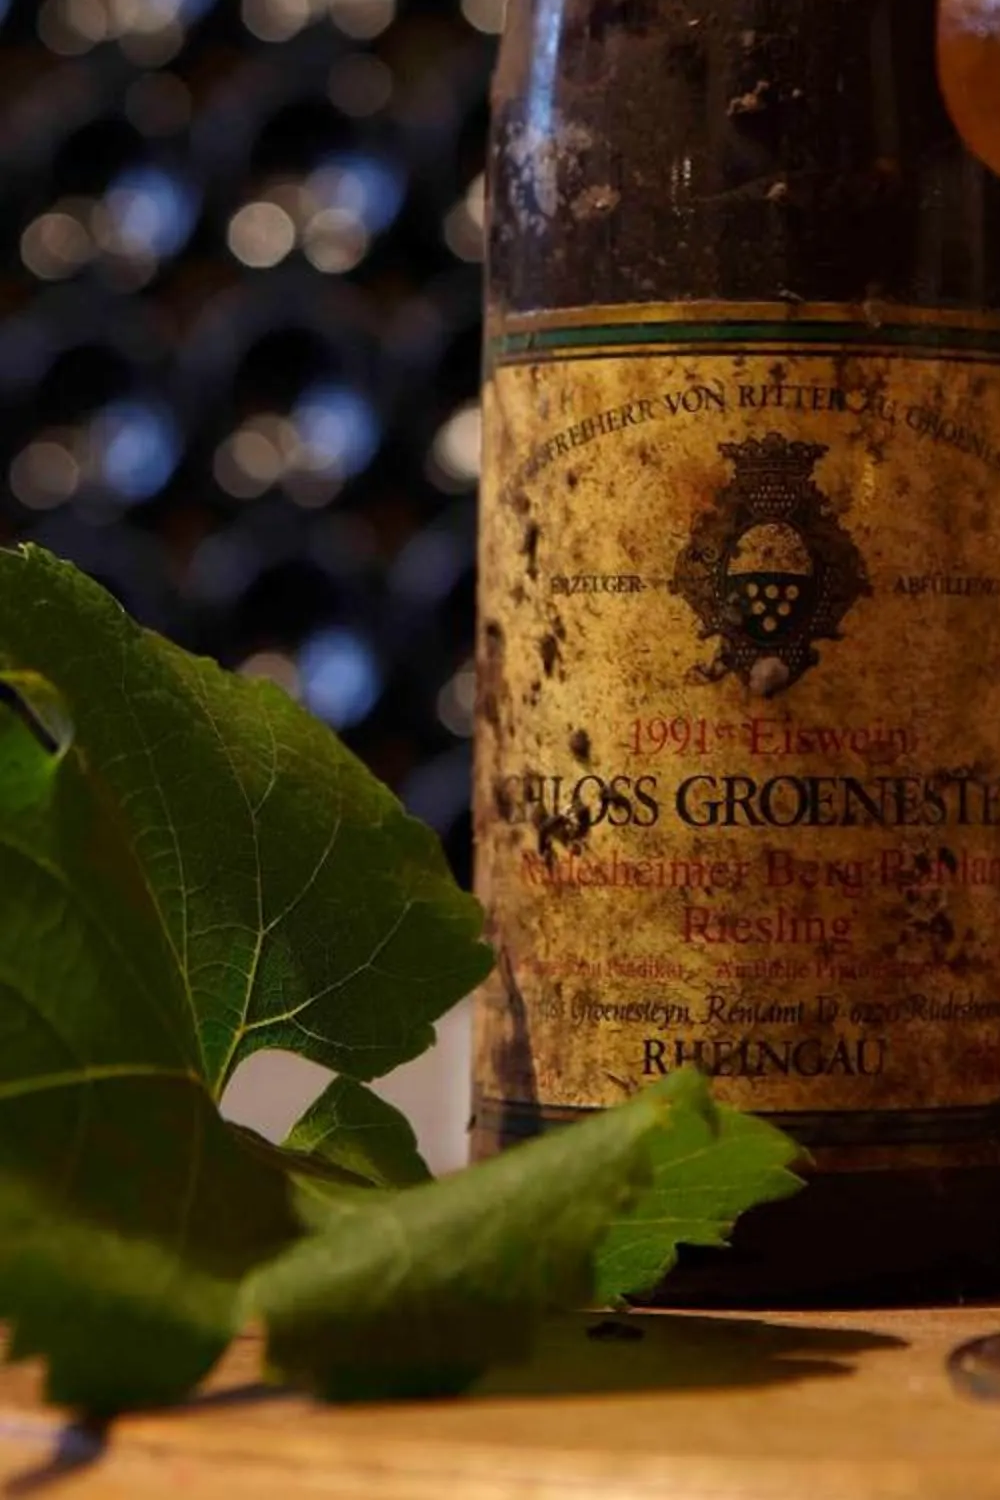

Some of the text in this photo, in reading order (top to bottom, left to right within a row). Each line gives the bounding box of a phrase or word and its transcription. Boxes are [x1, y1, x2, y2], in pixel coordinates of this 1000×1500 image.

[664, 383, 724, 415] VON
[682, 905, 854, 954] Riesling
[642, 1038, 887, 1077] RHEINGAU
